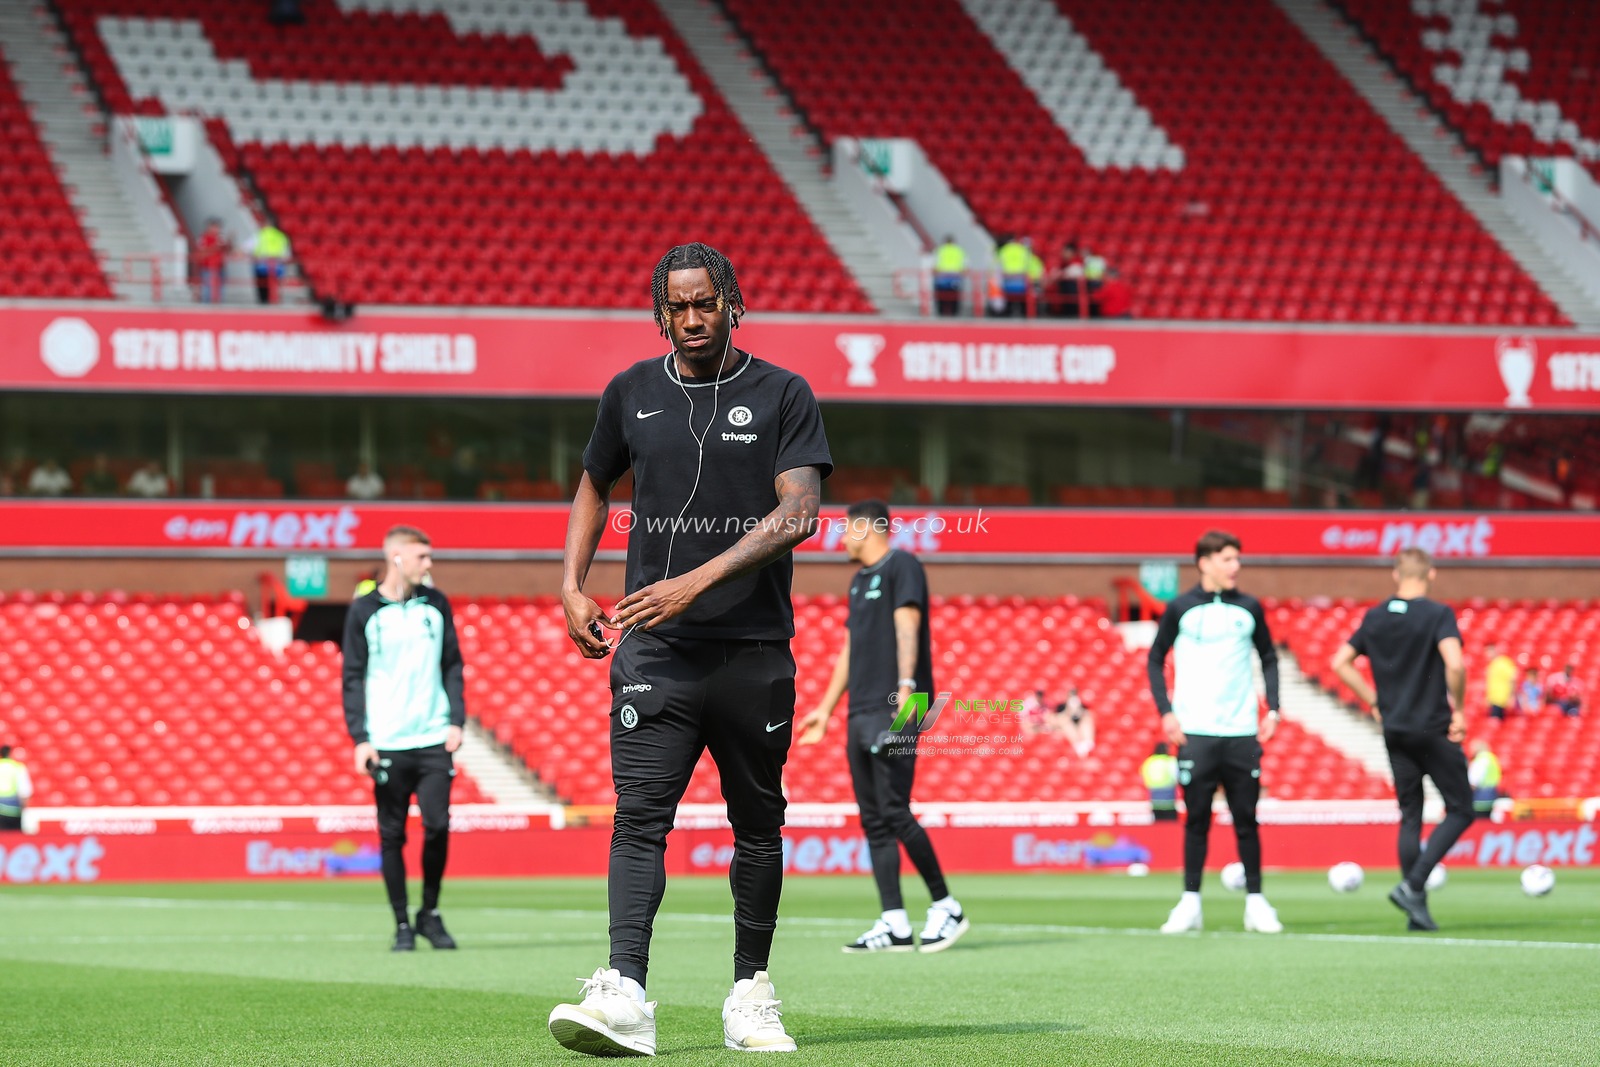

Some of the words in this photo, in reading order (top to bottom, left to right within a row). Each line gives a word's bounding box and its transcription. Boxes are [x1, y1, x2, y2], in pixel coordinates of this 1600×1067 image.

[182, 329, 216, 371] FA
[219, 330, 377, 373] COMMUNITY
[379, 332, 477, 374] SHIELD
[965, 342, 1060, 382] LEAGUE
[1061, 344, 1116, 384] CUP
[721, 432, 758, 444] trivago
[229, 505, 360, 547] next
[1379, 516, 1494, 557] next
[622, 683, 652, 694] trivago
[0, 836, 105, 884] ext
[1477, 824, 1598, 867] next
